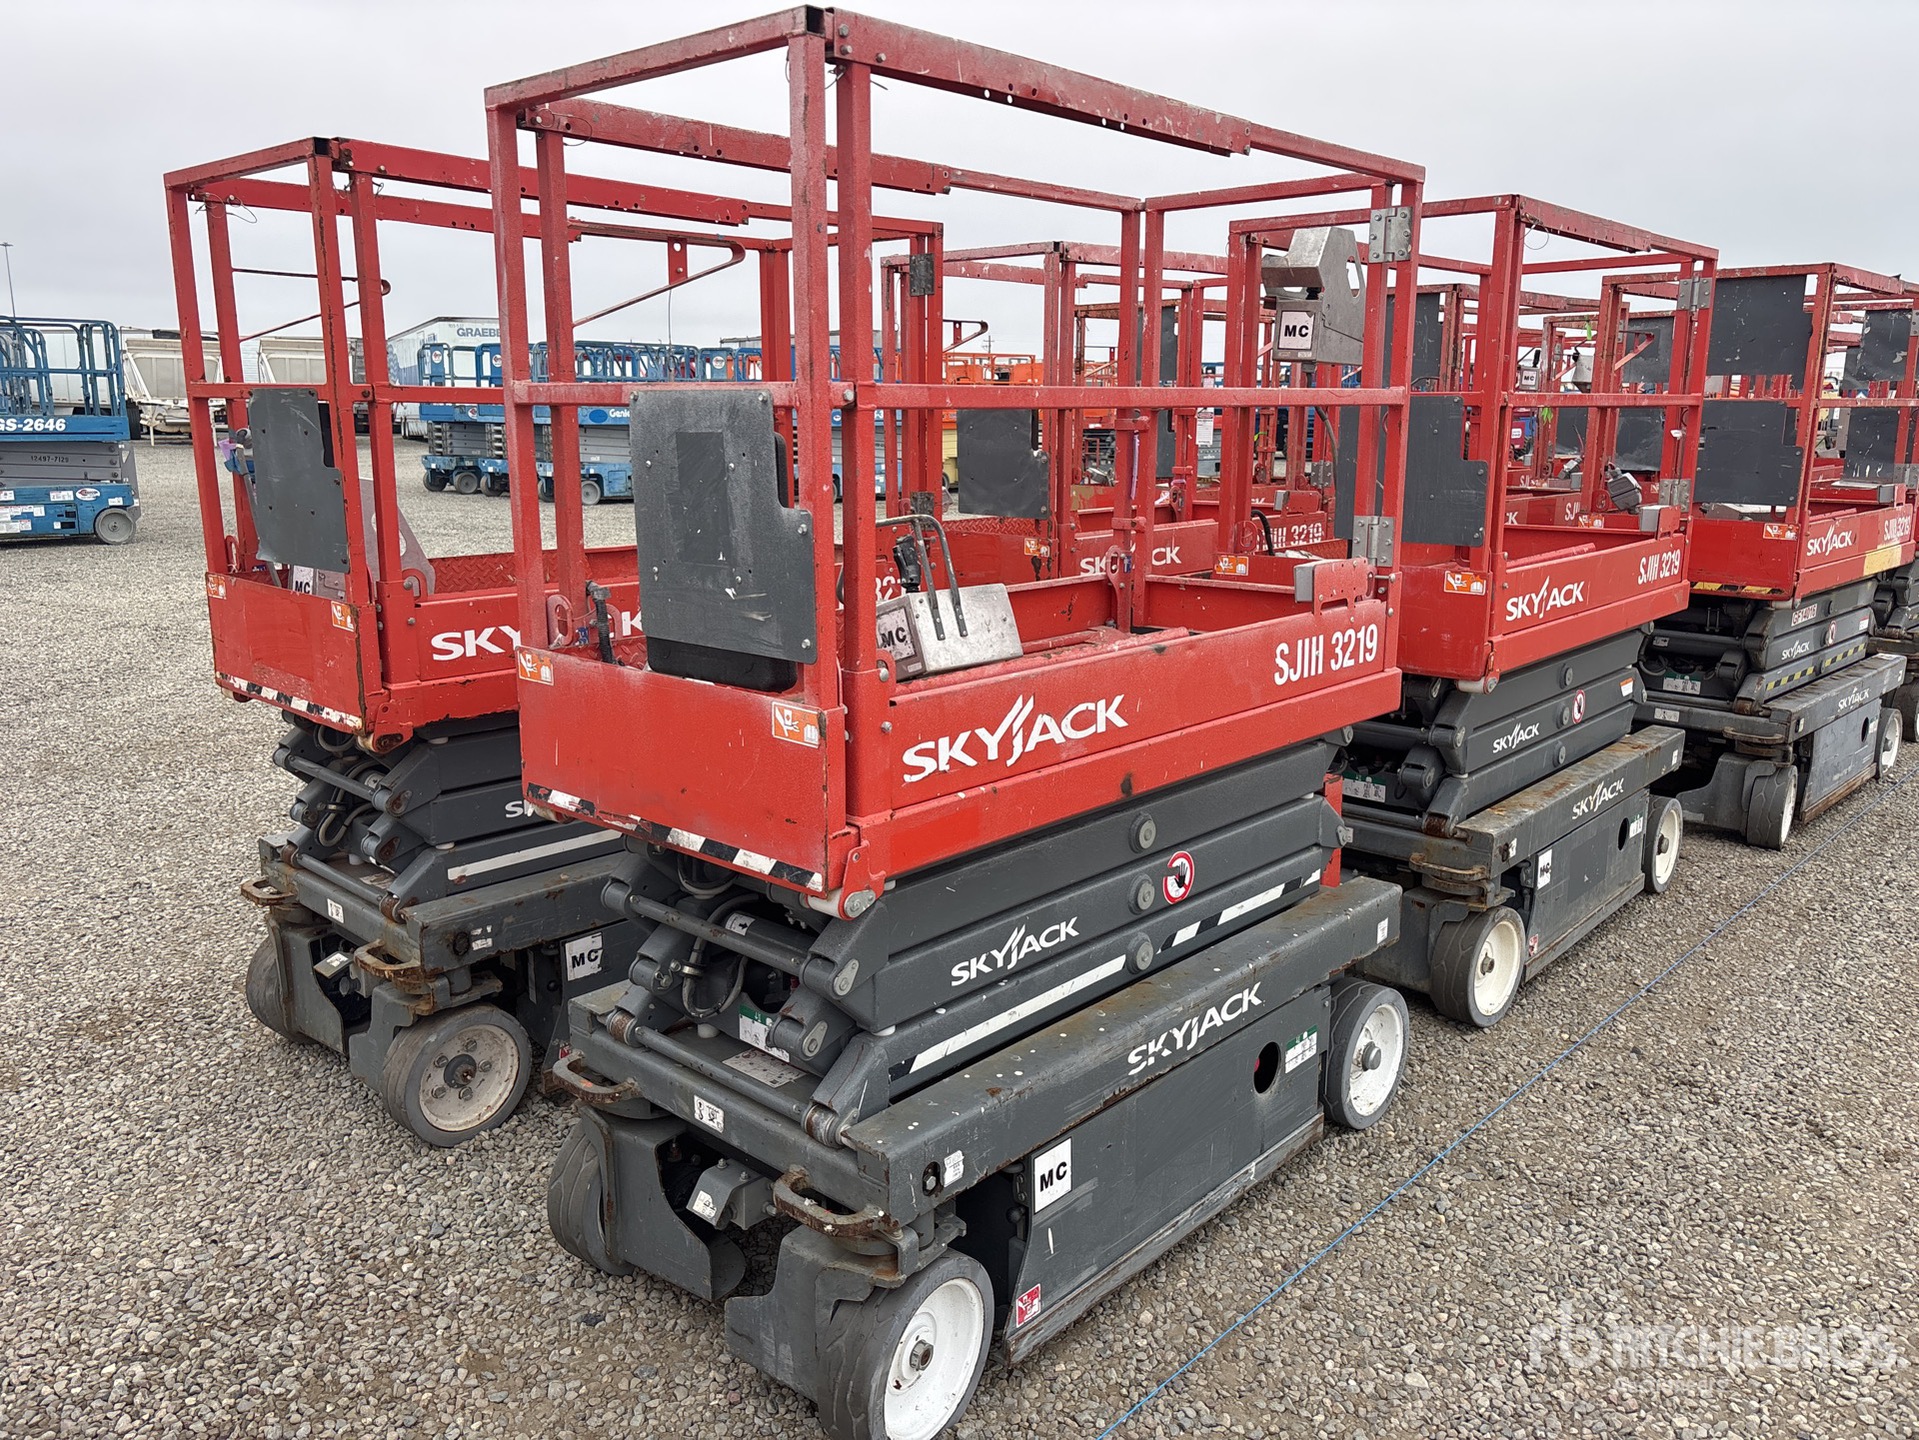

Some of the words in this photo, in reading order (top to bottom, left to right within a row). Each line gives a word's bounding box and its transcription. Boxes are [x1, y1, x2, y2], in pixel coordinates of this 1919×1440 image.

[1284, 325, 1309, 337] MC
[1291, 522, 1322, 546] 3219
[1806, 524, 1853, 556] SKYJACK
[1660, 549, 1681, 579] 3219
[295, 580, 311, 594] MC
[1505, 576, 1585, 622] SKYJACK
[880, 627, 907, 648] MC
[1330, 623, 1378, 671] 3219
[1781, 640, 1810, 660] SKYJACK
[902, 694, 1129, 782] SKYJACK
[1493, 722, 1539, 753] SKYJACK
[1572, 778, 1624, 820] SKYJACK
[572, 949, 599, 969] MC
[951, 916, 1080, 986] SKYJACK
[1128, 981, 1262, 1075] SKYJACK
[1040, 1161, 1068, 1192] MC
